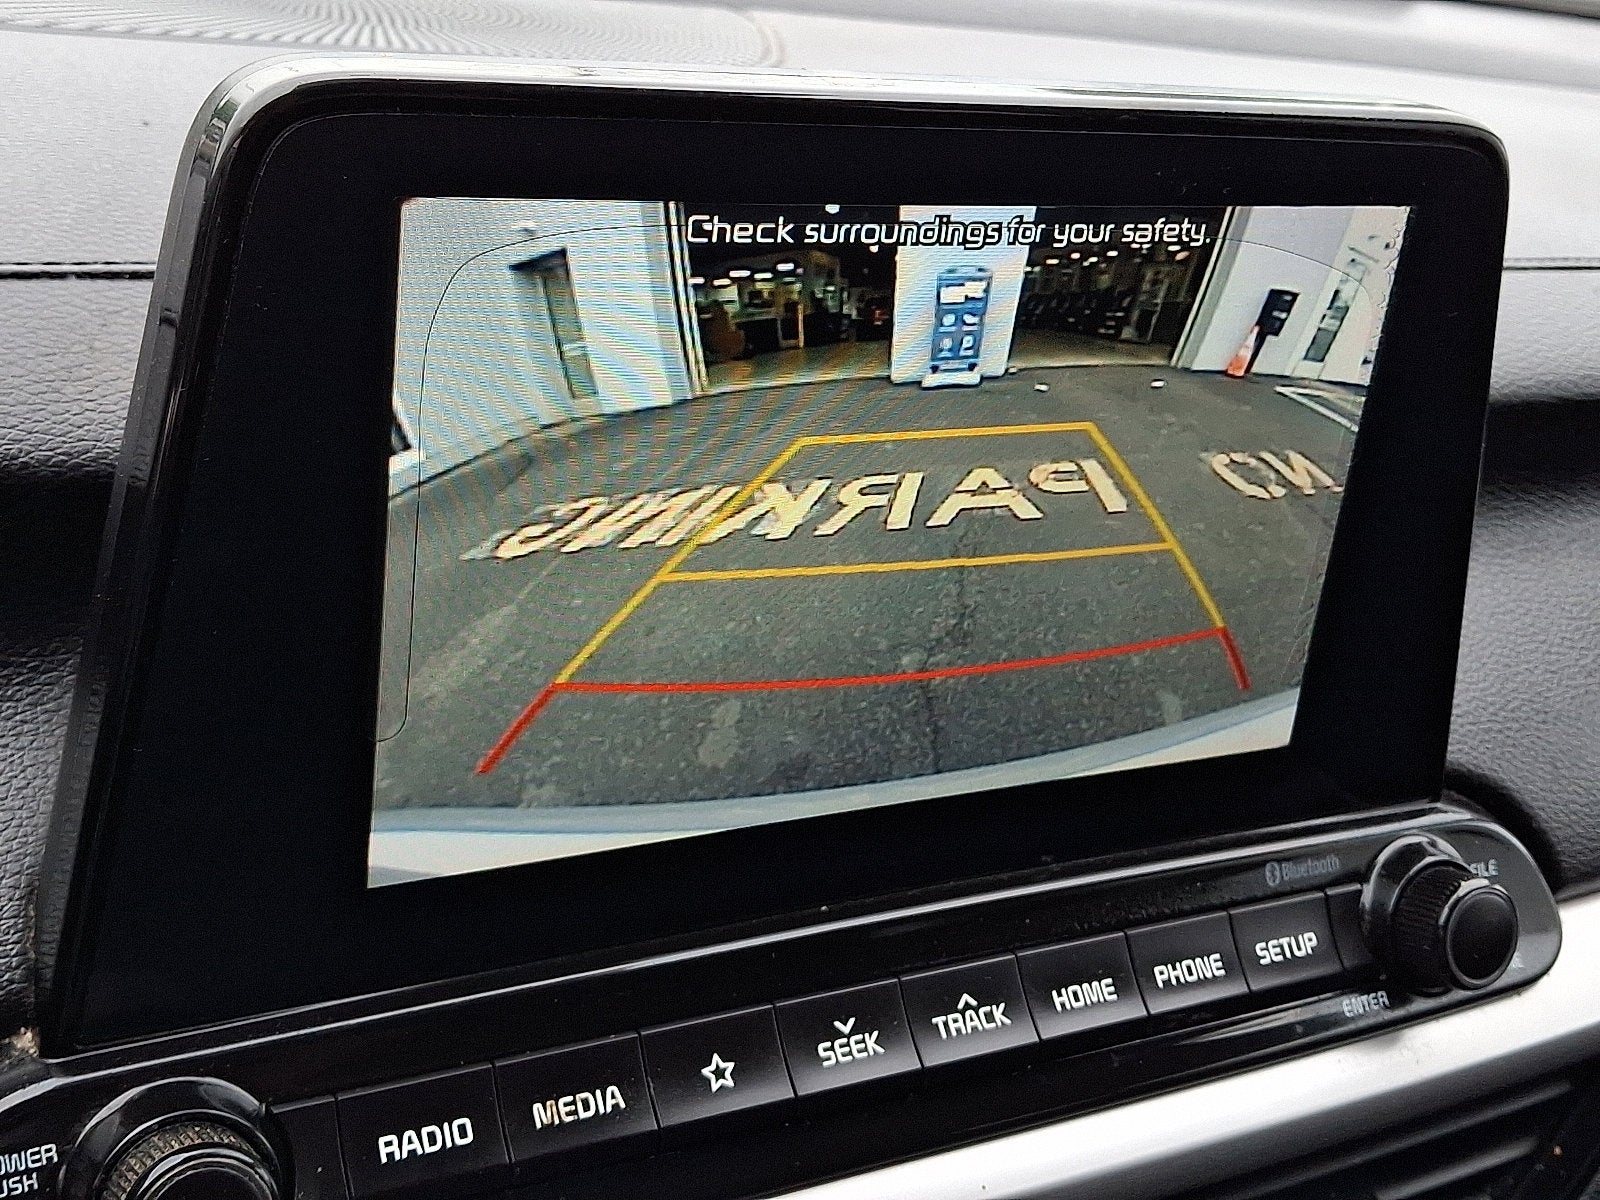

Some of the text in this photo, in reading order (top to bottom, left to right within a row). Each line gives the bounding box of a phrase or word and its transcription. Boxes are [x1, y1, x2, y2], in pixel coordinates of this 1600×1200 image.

[686, 213, 1212, 250] Check surroundings for your safety.
[1254, 932, 1319, 965] SETUP
[1153, 952, 1227, 989] PHONE
[1051, 978, 1118, 1012] HOME
[1342, 990, 1391, 1018] ENTER
[931, 1003, 1012, 1040] TRACK
[817, 1029, 886, 1067] SEEK
[531, 1085, 626, 1130] MEDIA
[377, 1116, 475, 1164] RADIO
